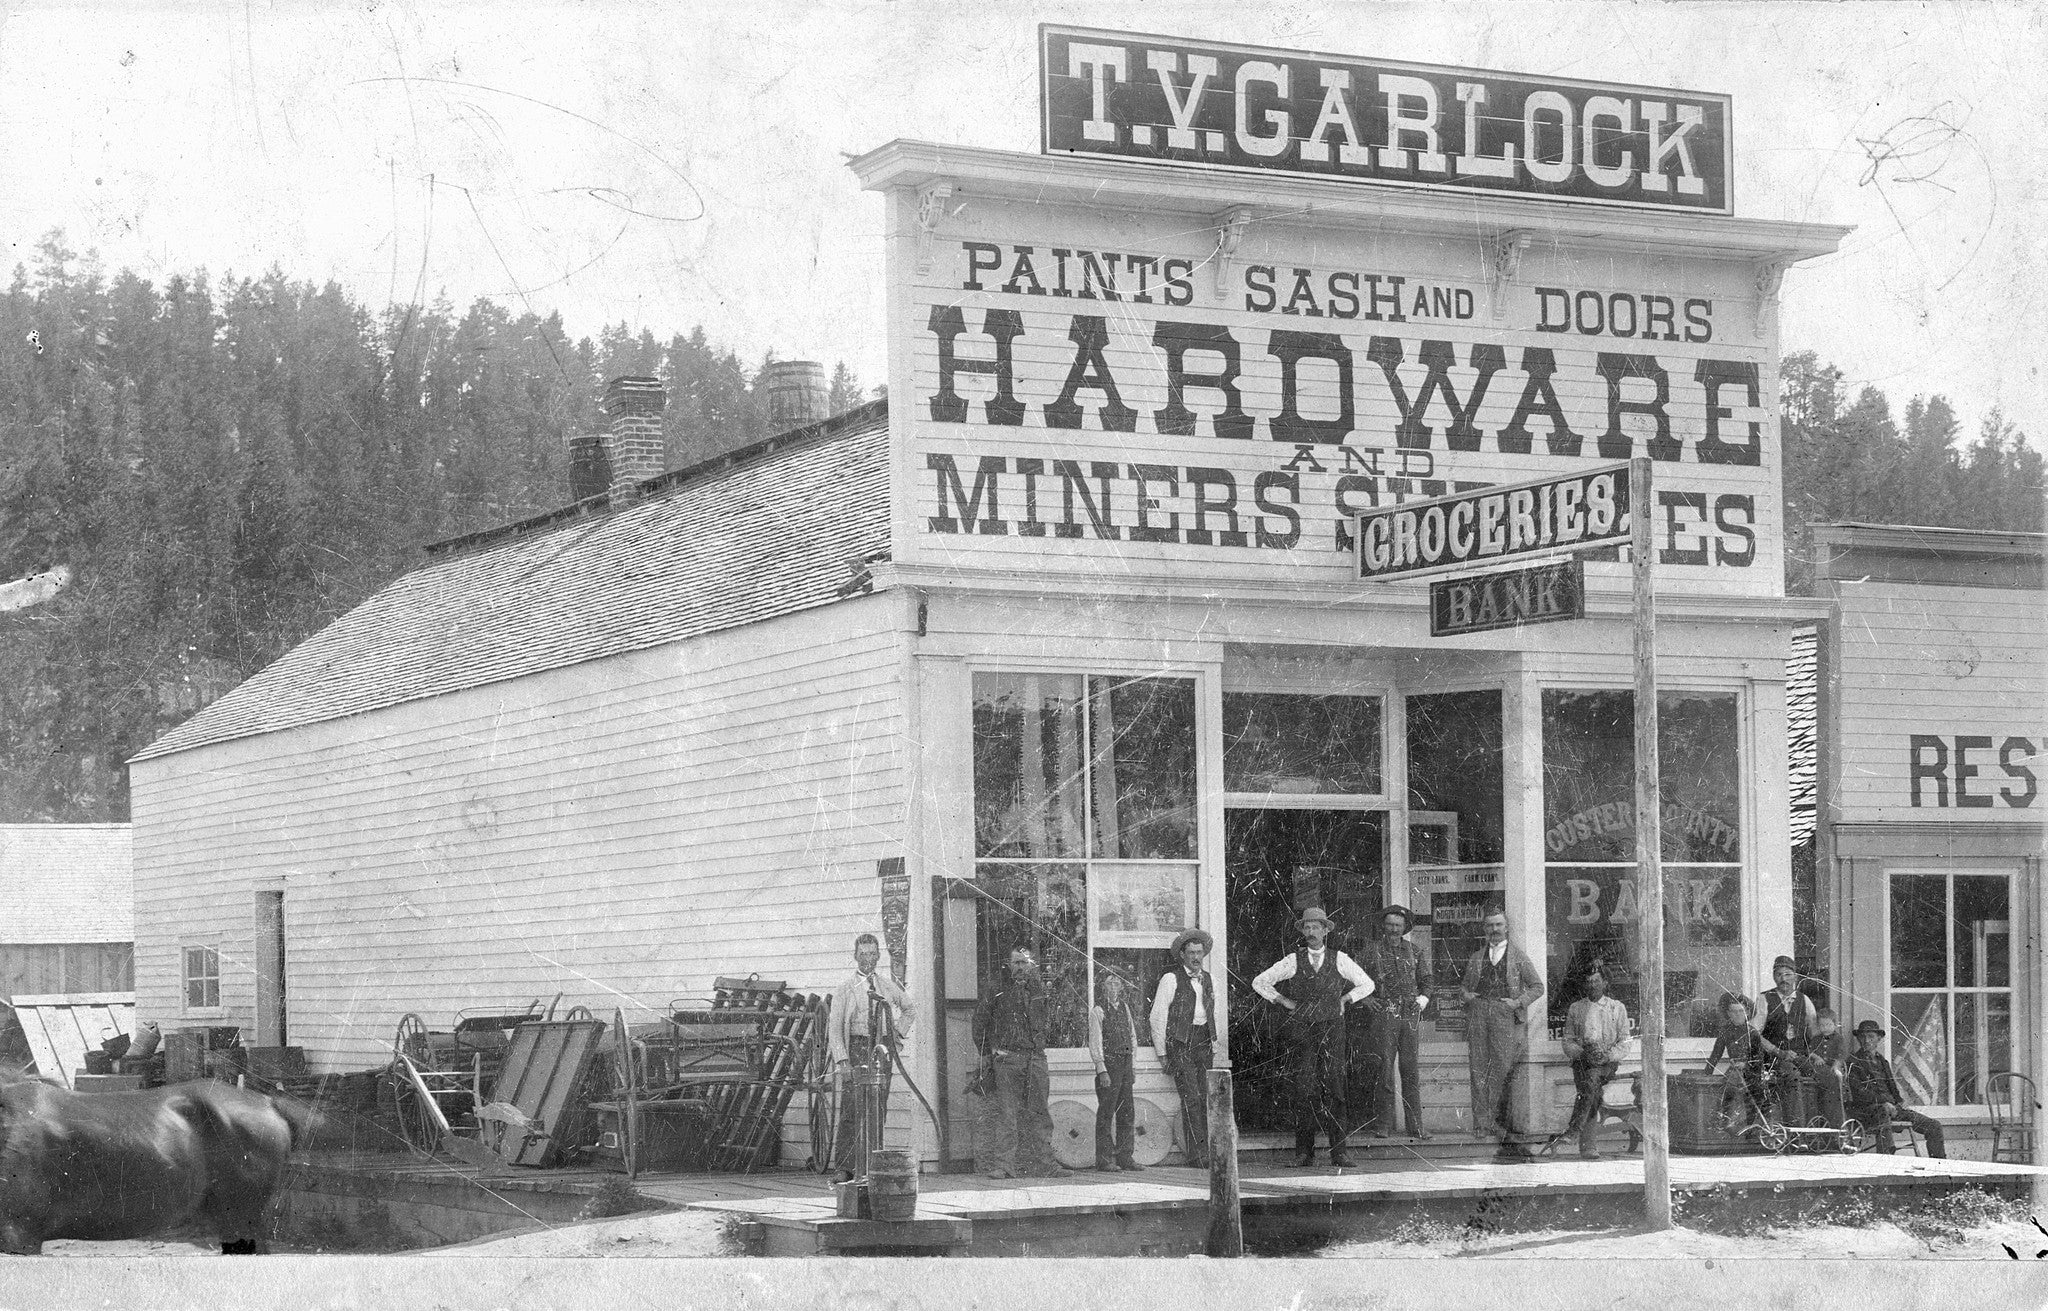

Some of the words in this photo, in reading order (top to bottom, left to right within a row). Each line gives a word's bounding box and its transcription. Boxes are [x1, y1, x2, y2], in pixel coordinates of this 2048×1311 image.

[1234, 60, 1705, 196] GARLOCK
[961, 241, 1194, 307] PAINTS
[1244, 264, 1406, 323] SASH
[1412, 286, 1475, 321] AND
[1535, 286, 1714, 344] DOORS
[927, 304, 1761, 467] HARDWARE
[1280, 444, 1435, 479] AND
[926, 453, 1301, 551] MINERS
[1448, 572, 1564, 628] BANK
[1909, 734, 2048, 808] RES
[1546, 801, 1635, 853] CUSTER
[1566, 879, 1728, 927] BANK
